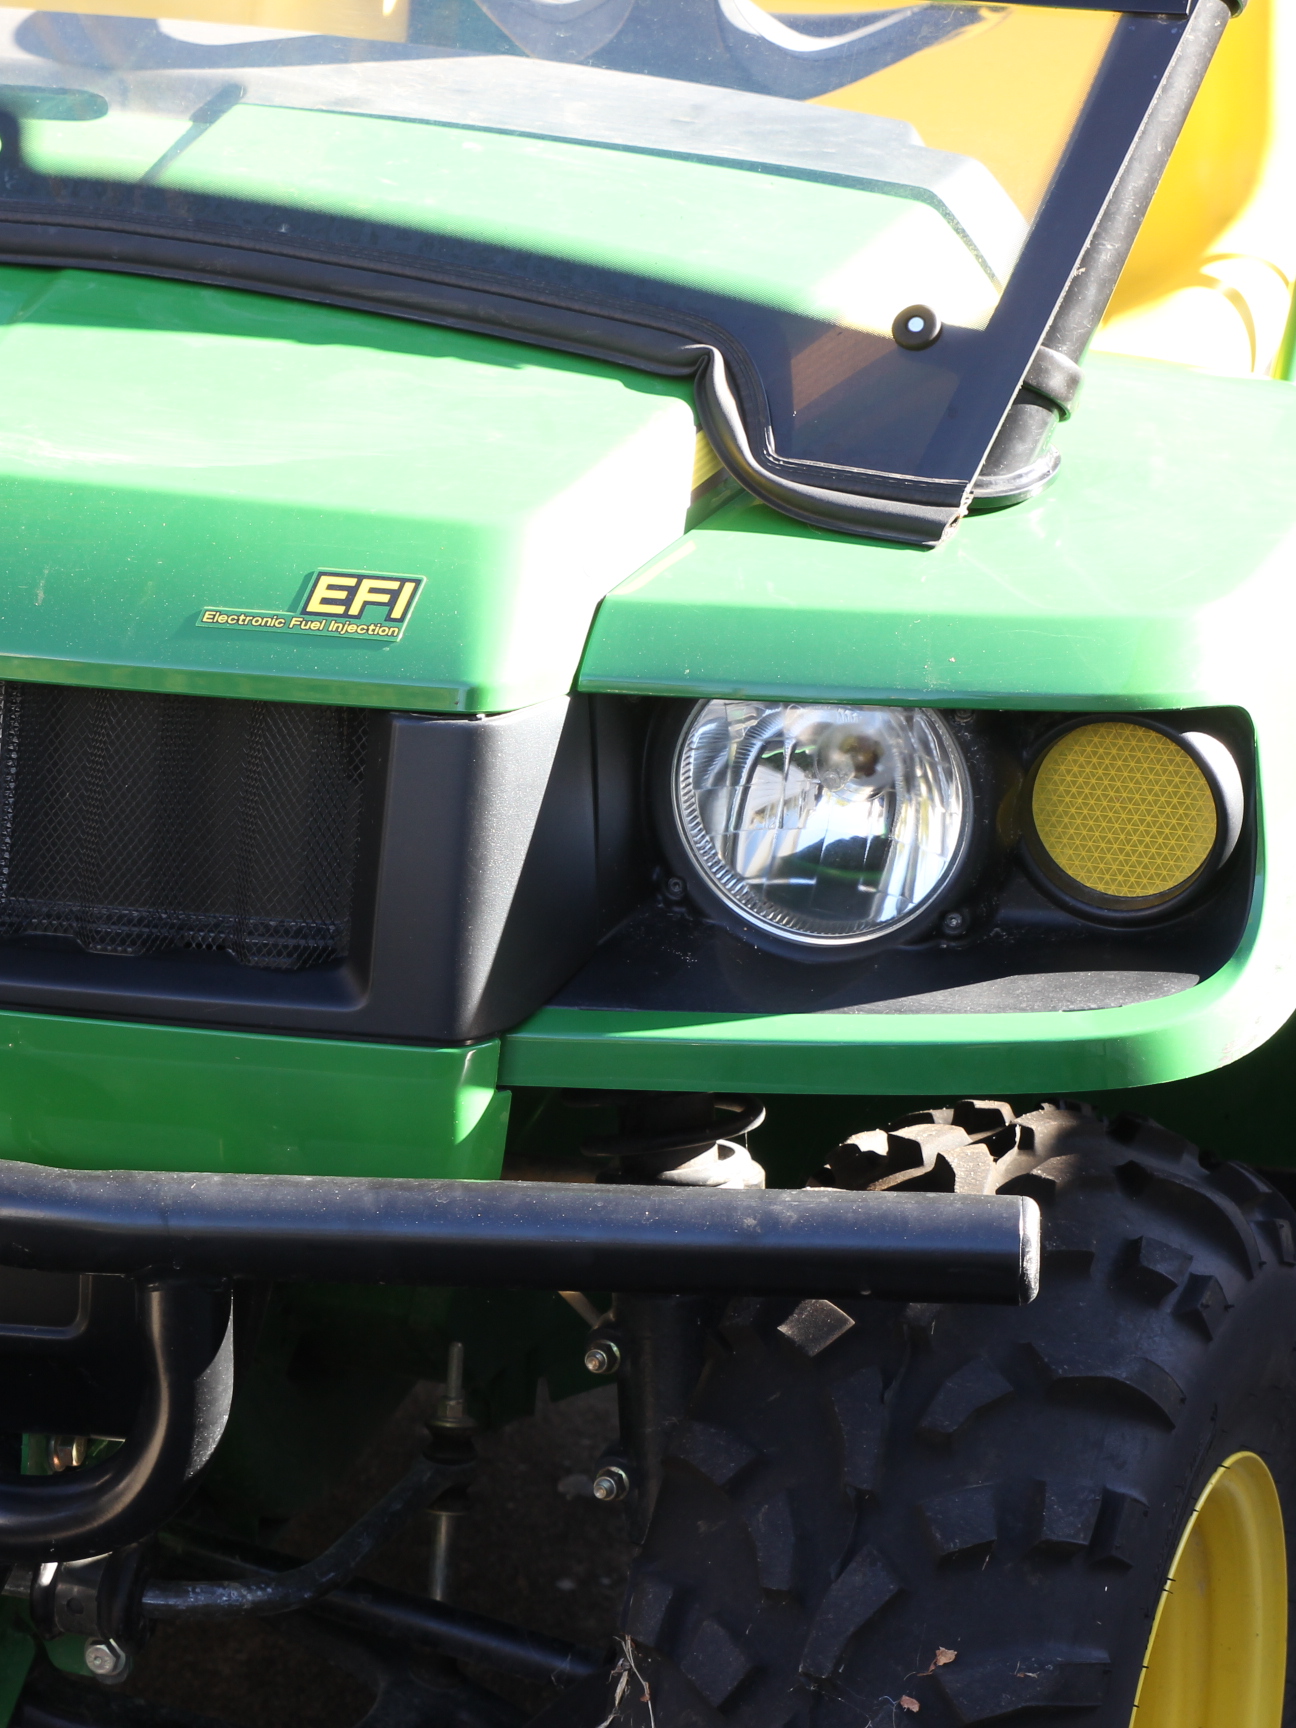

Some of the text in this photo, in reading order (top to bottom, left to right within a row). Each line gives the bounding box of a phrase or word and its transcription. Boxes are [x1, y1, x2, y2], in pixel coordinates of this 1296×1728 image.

[305, 575, 416, 619] EFI
[202, 610, 399, 637] Electronic Fuel Injection
